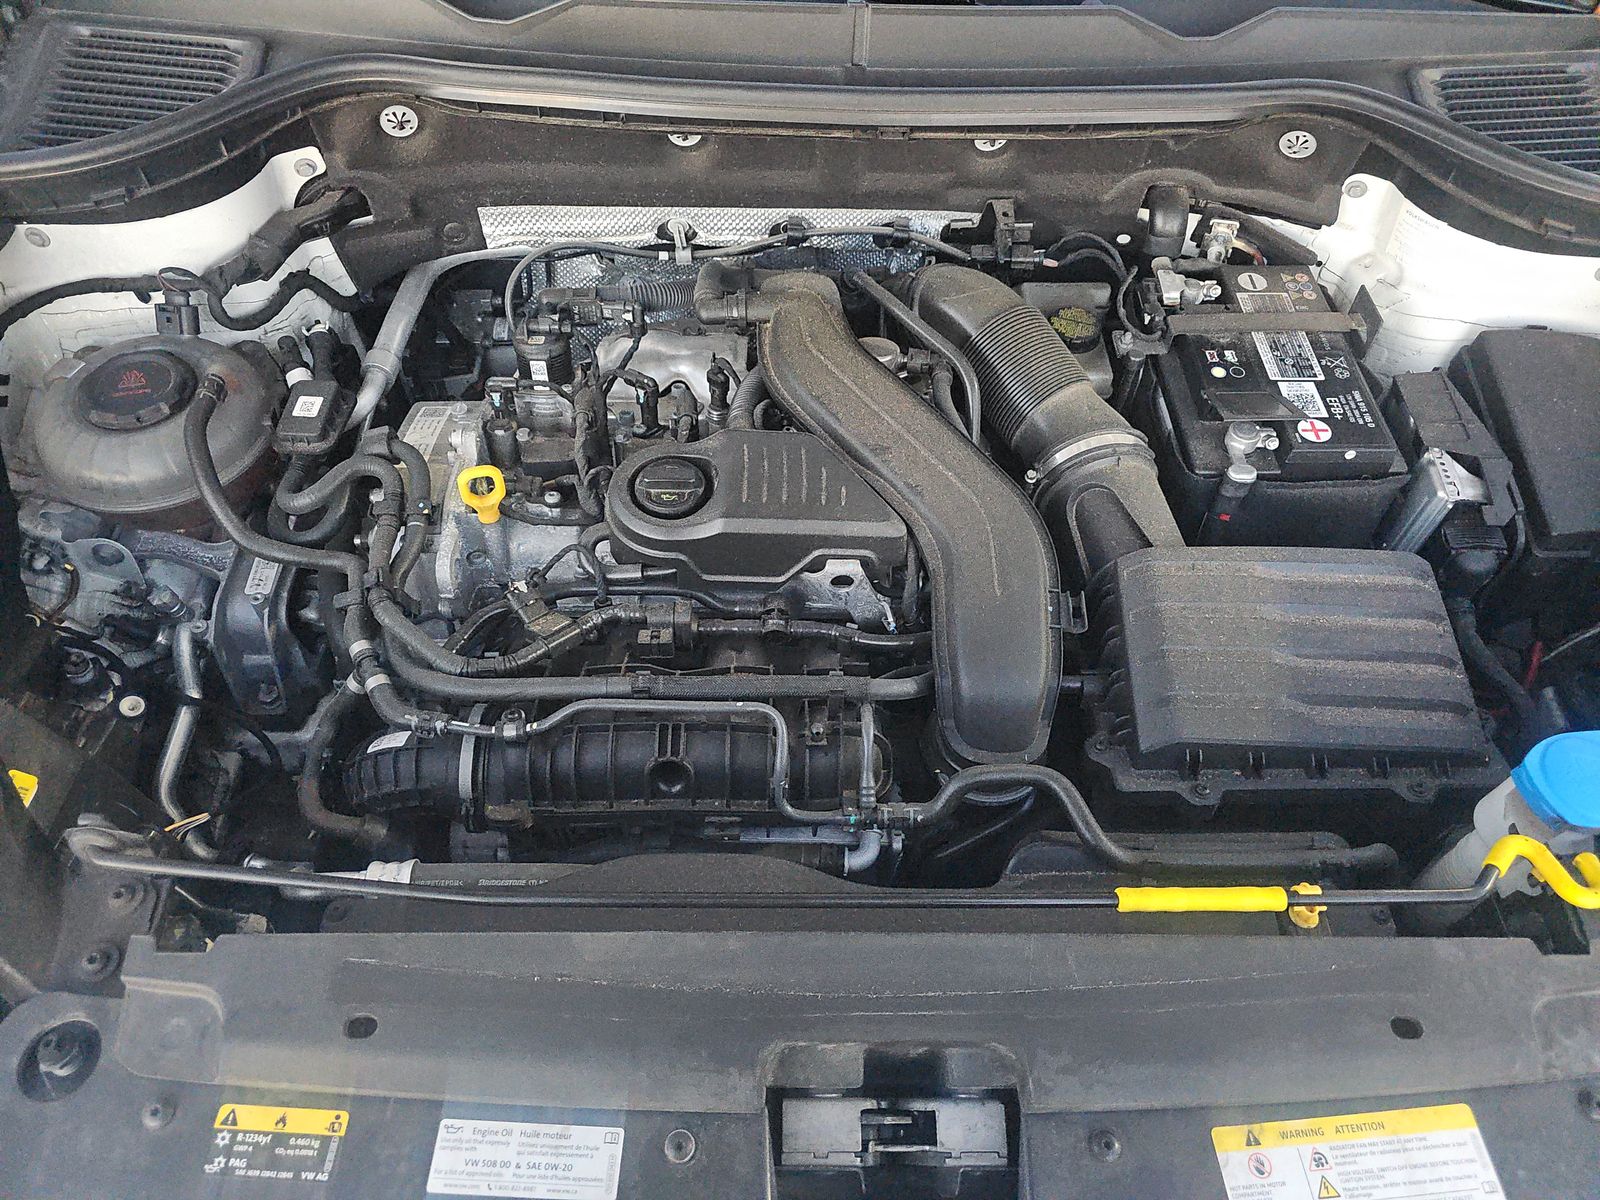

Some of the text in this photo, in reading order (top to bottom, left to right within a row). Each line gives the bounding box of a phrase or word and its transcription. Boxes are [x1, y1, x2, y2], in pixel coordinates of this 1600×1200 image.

[1326, 397, 1344, 421] EFB+
[478, 878, 527, 886] BRIDGESTONE
[472, 1126, 573, 1141] Engine Oil Huile moteur
[1278, 1121, 1386, 1140] WARNING ATTENTION
[236, 1133, 273, 1146] R-1234yf
[228, 1158, 248, 1168] PAG
[464, 1158, 573, 1172] VW 508 00 & SAE 0W-20
[301, 1171, 316, 1180] VW
[315, 1172, 329, 1181] AG
